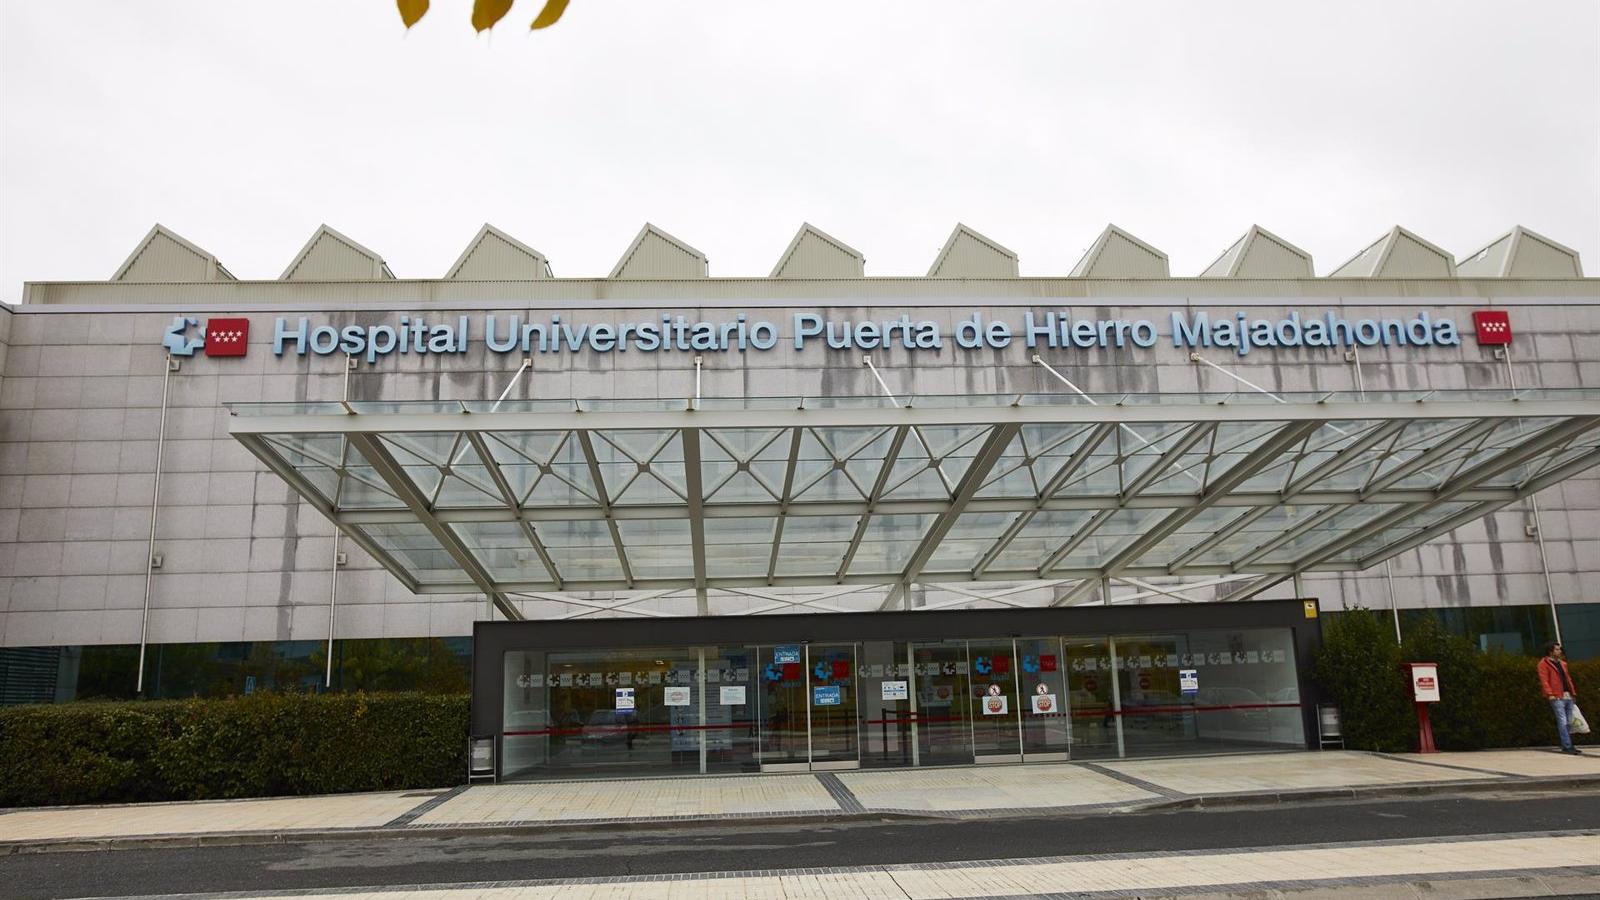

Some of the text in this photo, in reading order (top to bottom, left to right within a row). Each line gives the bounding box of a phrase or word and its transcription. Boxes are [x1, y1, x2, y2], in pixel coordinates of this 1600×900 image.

[273, 310, 1460, 363] Hospital Universitario Puerta de Hierro Majadahonda
